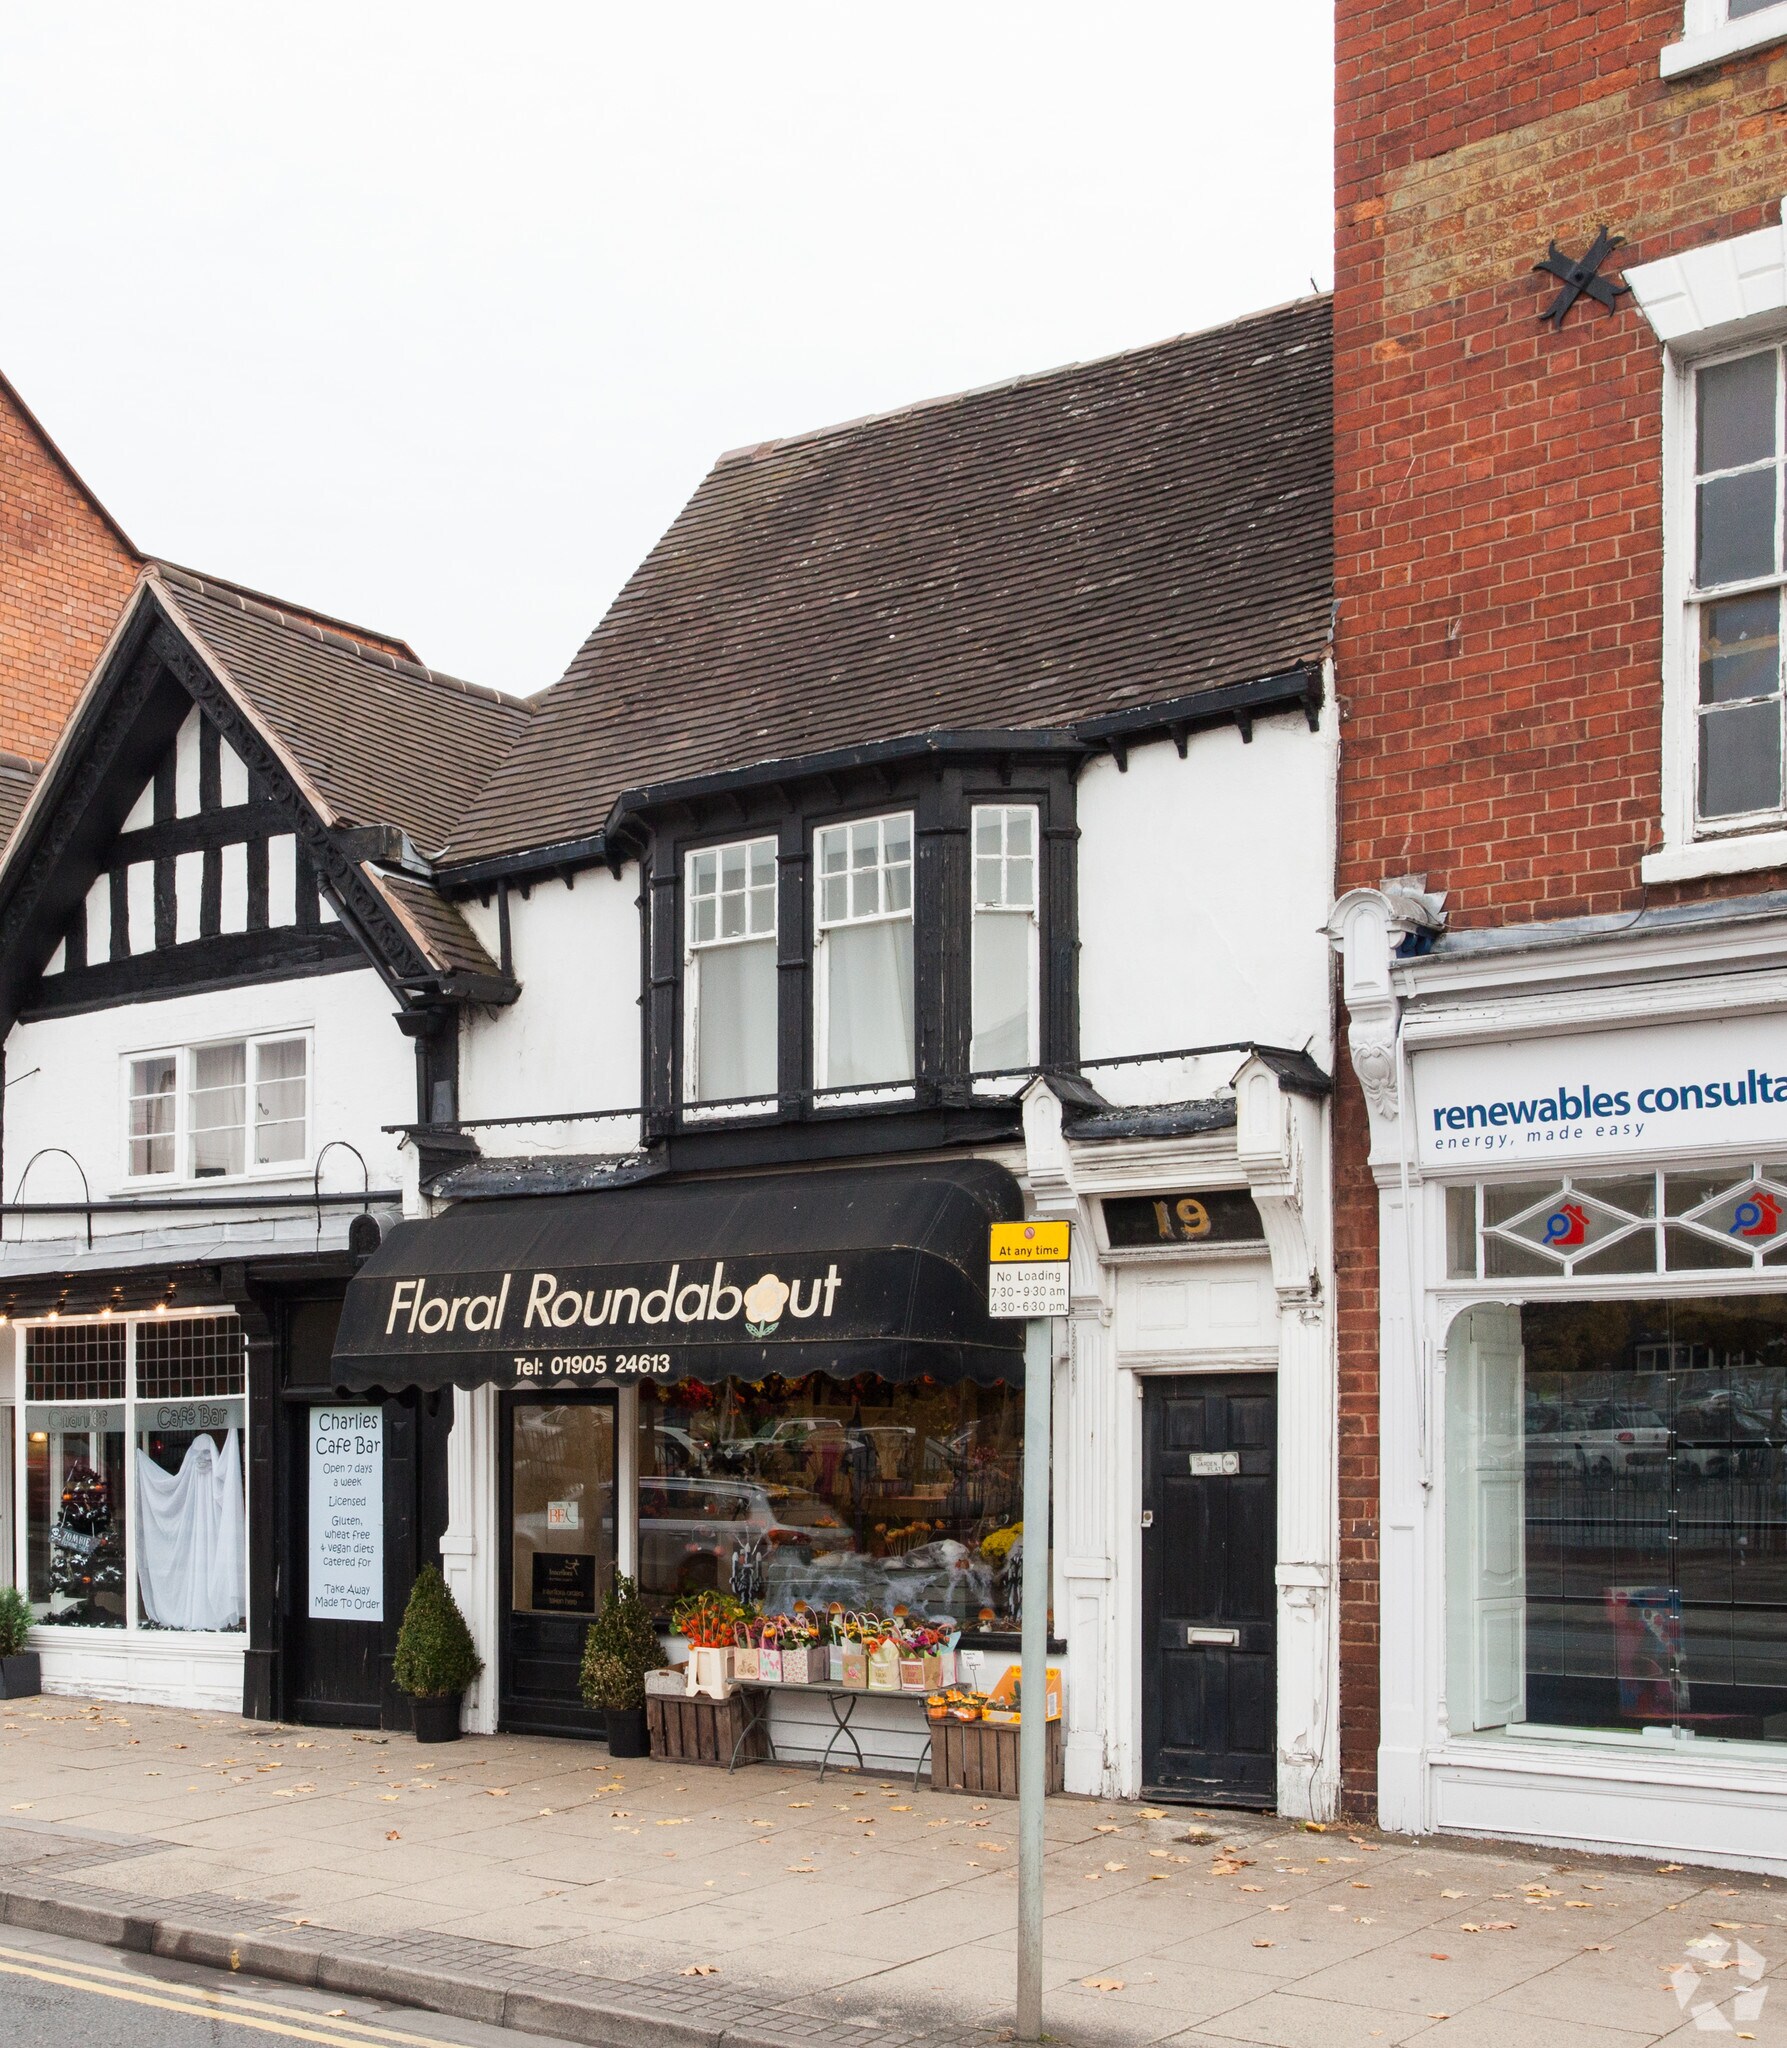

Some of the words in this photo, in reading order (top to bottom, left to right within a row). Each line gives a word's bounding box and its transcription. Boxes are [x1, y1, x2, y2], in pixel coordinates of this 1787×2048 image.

[1433, 1084, 1631, 1131] renewables
[1435, 1131, 1514, 1150] energy,
[1527, 1125, 1584, 1143] made
[1596, 1121, 1645, 1137] easy
[1152, 1198, 1211, 1239] 19
[999, 1246, 1011, 1256] At
[1014, 1247, 1032, 1257] any
[1035, 1245, 1059, 1255] time
[996, 1272, 1012, 1281] No
[1018, 1270, 1061, 1282] Loading
[1049, 1288, 1065, 1296] am
[385, 1273, 511, 1335] Floral
[514, 1356, 543, 1376] Tel:
[550, 1354, 608, 1375] 01905
[615, 1353, 671, 1374] 24613
[157, 1403, 195, 1429] Café
[198, 1404, 228, 1427] Bar
[319, 1412, 378, 1431] Charlies
[316, 1437, 351, 1455] Cafe
[354, 1436, 381, 1455] Bar
[323, 1463, 345, 1474] Open
[347, 1464, 352, 1473] 7
[354, 1463, 373, 1474] days
[333, 1478, 338, 1487] a
[340, 1478, 362, 1486] week
[329, 1496, 366, 1507] Licensed
[331, 1515, 363, 1526] Gluten,
[63, 1530, 91, 1547] ZOMBIE
[324, 1530, 350, 1539] wheat
[352, 1530, 371, 1540] free
[328, 1543, 351, 1554] vegan
[354, 1543, 375, 1553] diets
[357, 1558, 372, 1568] for
[324, 1583, 345, 1595] Take
[347, 1584, 371, 1596] Away
[314, 1597, 339, 1608] Made
[340, 1598, 352, 1609] To
[354, 1599, 381, 1609] Order
